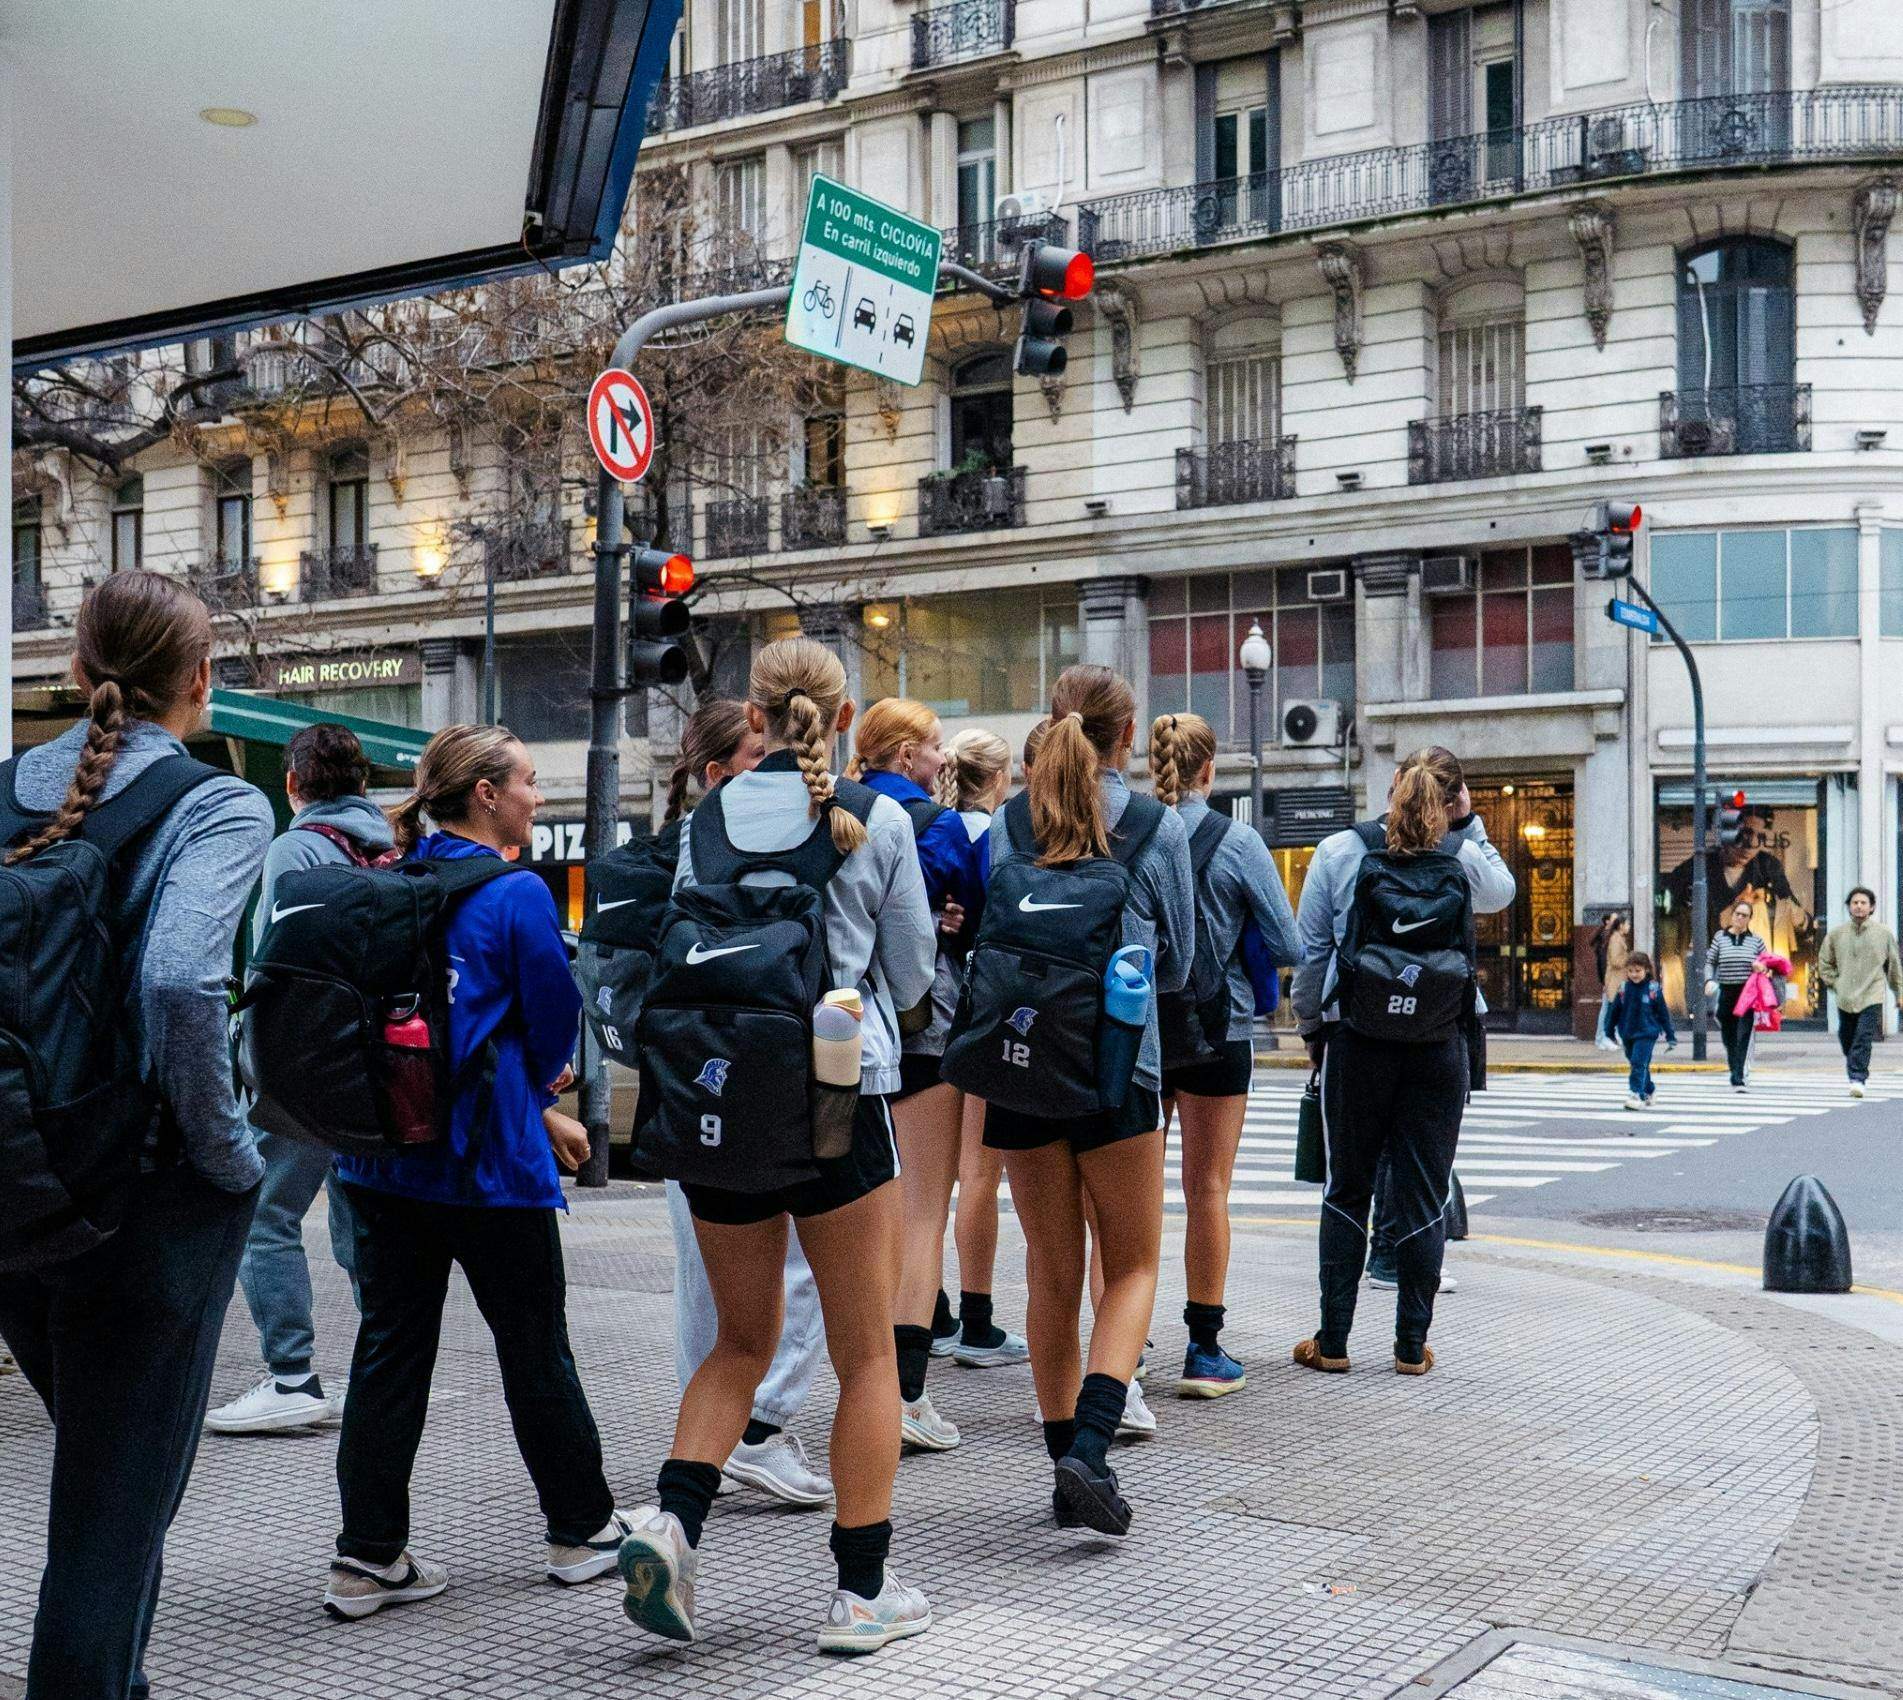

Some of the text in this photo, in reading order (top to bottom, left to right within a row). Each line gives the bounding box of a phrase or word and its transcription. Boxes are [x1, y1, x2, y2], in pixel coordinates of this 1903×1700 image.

[817, 193, 826, 212] A
[829, 198, 851, 222] 100
[853, 212, 877, 234] mts.
[823, 221, 921, 278] En carril izquierdo
[279, 658, 403, 685] HAIR RECOVERY
[1387, 994, 1418, 1016] 28
[601, 1023, 624, 1051] 16
[1001, 1038, 1031, 1069] 12
[700, 1113, 722, 1147] 9
